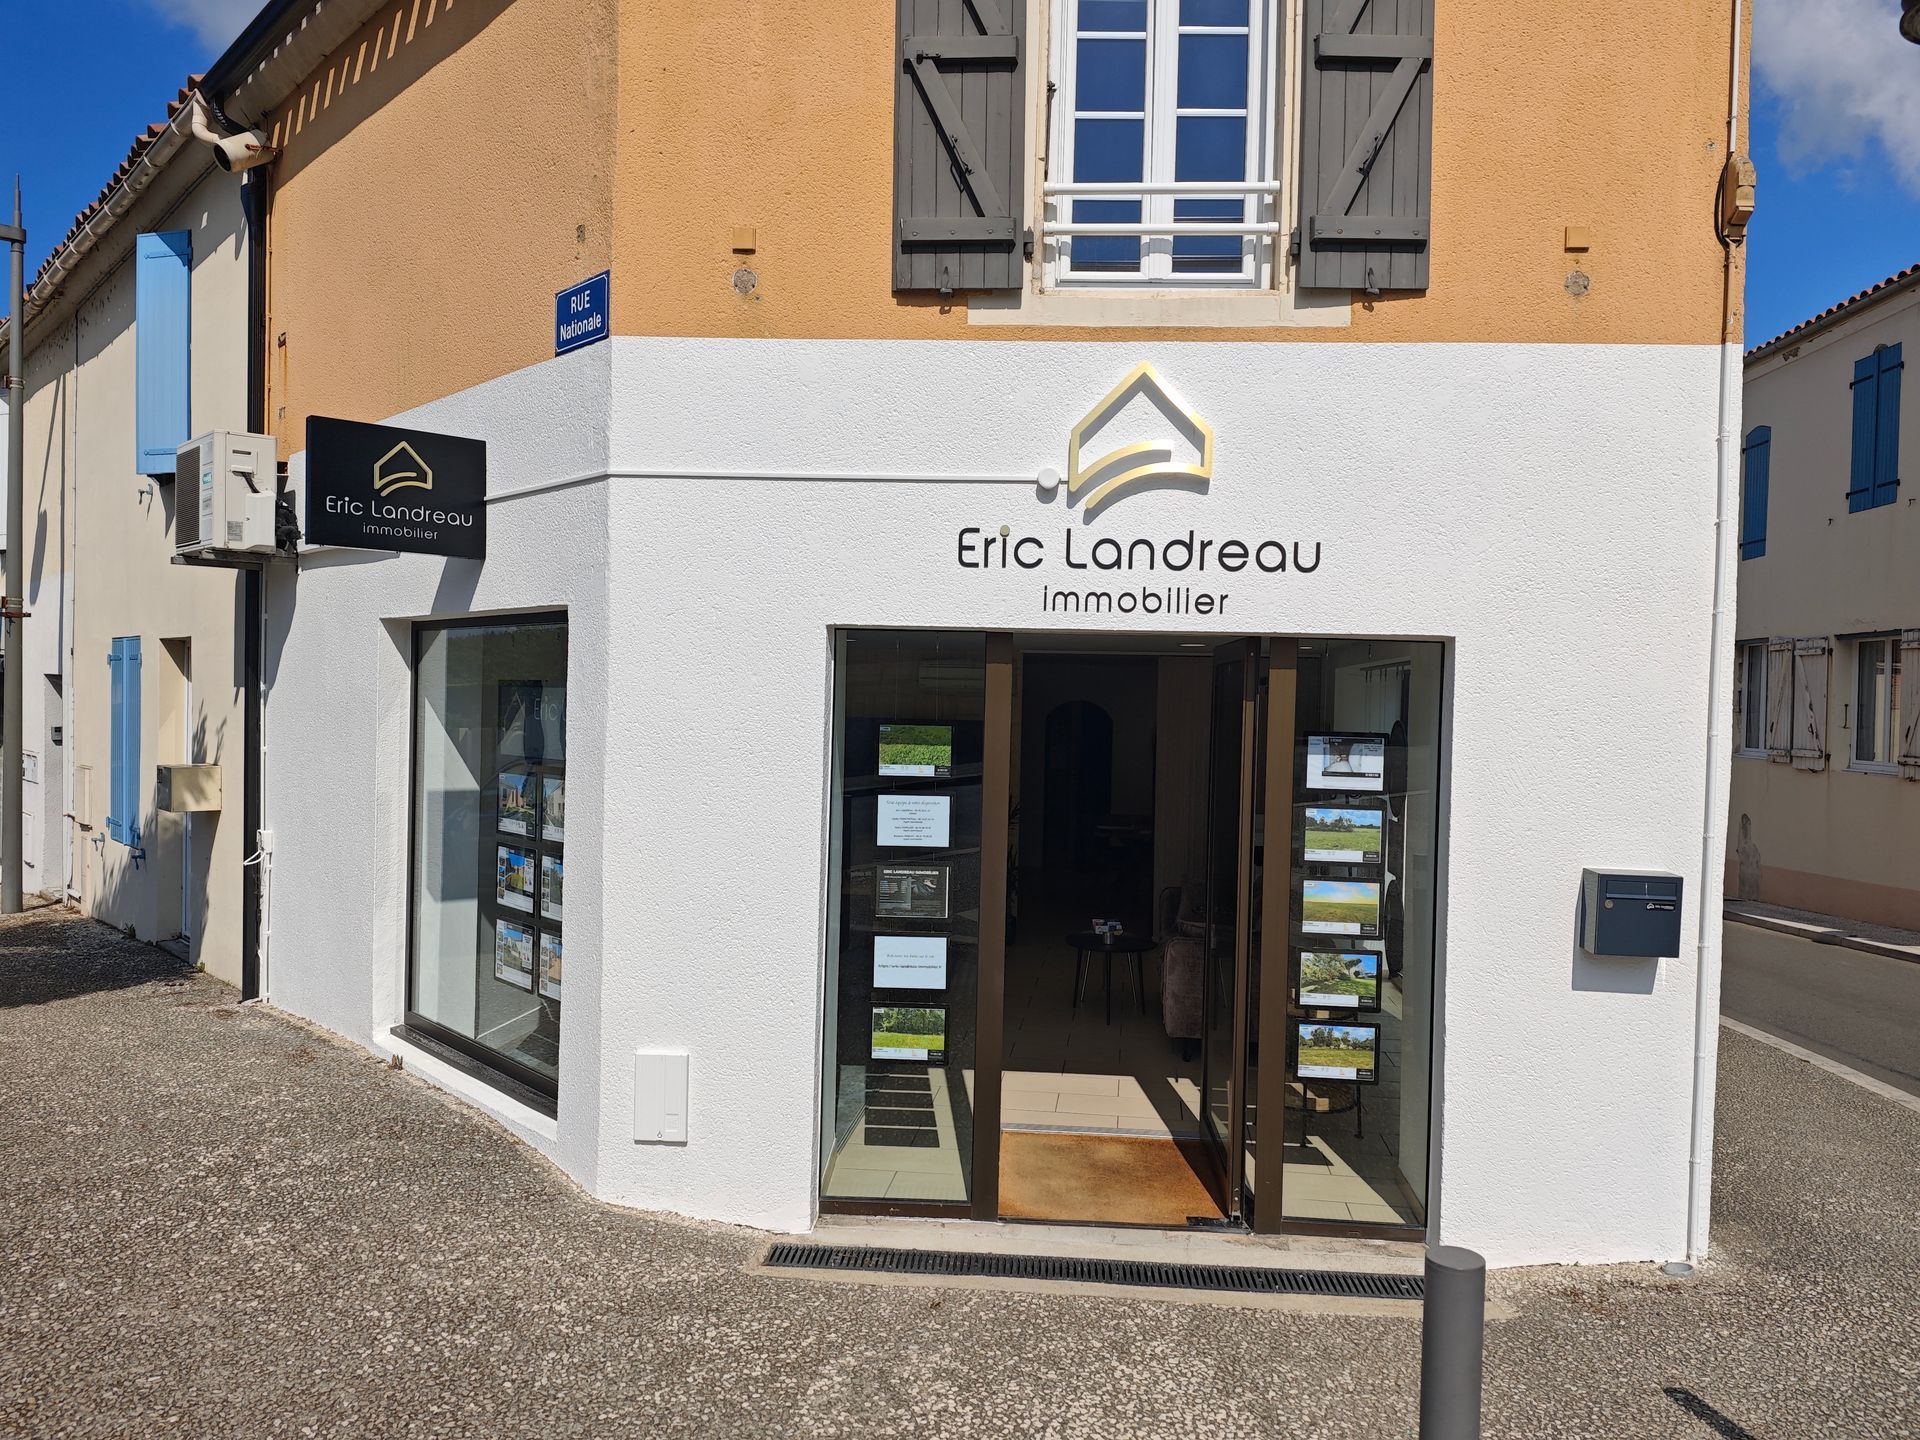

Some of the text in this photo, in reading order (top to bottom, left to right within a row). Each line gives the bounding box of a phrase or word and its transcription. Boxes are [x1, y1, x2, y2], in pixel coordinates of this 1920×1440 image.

[570, 290, 591, 314] RUE
[560, 312, 602, 341] Nationale
[326, 495, 473, 527] Eric Landreau
[363, 522, 439, 540] immobilier
[958, 525, 1321, 573] Eric Landreau
[1043, 585, 1229, 615] immobilier
